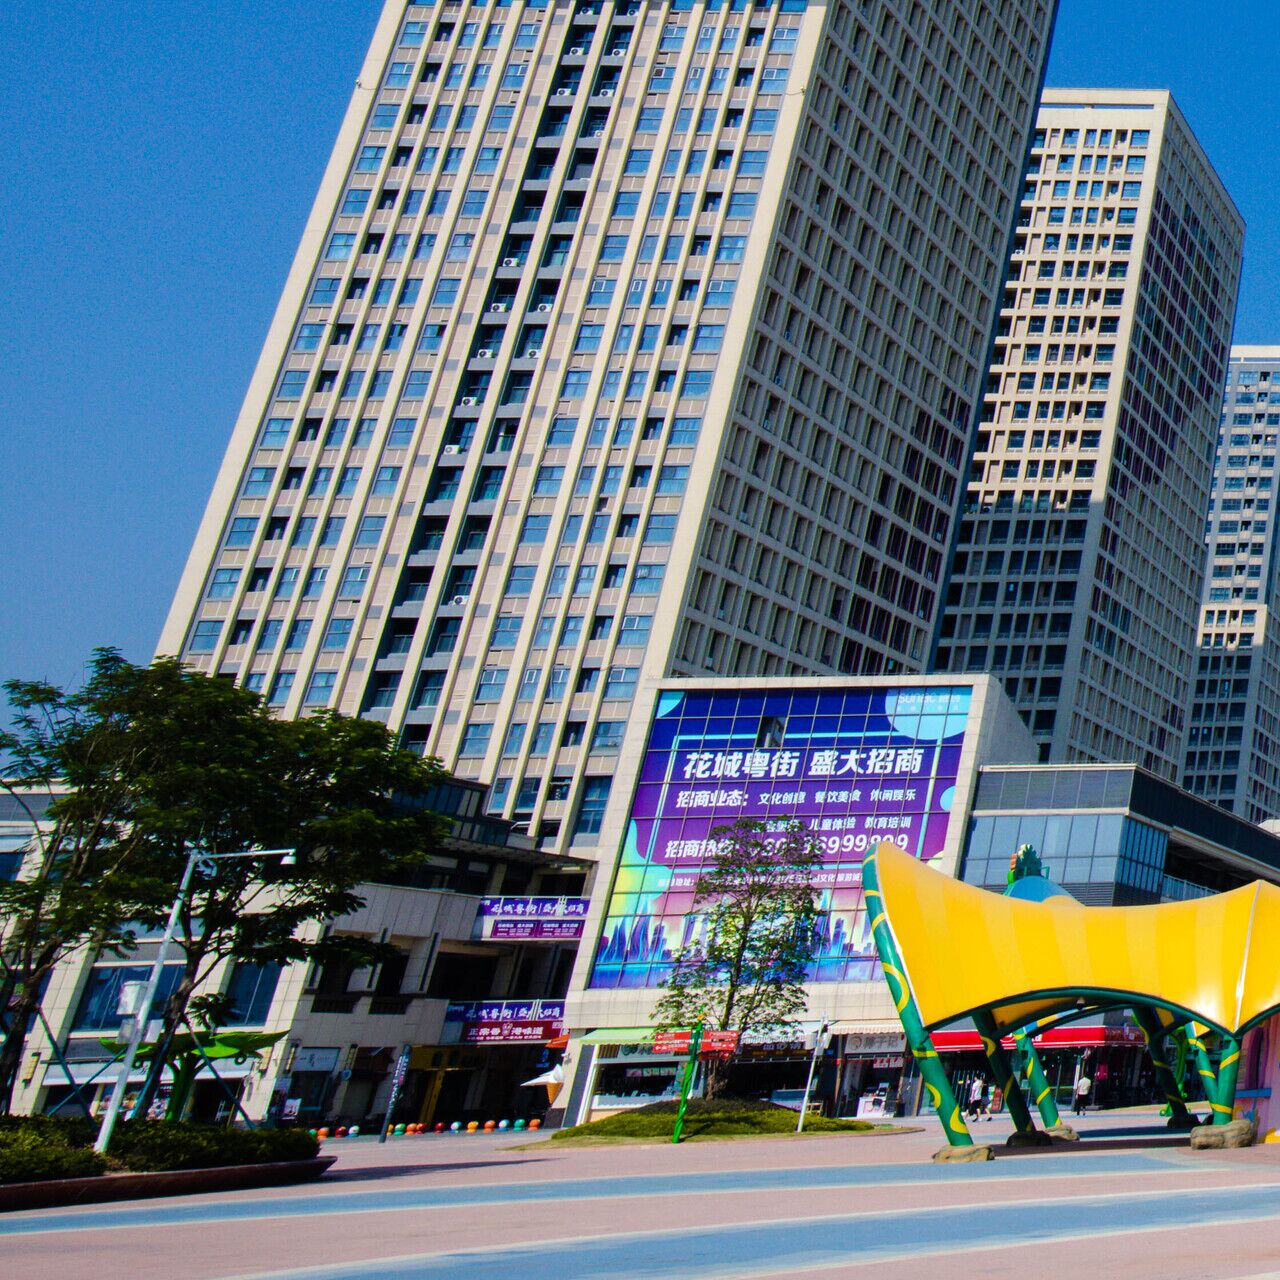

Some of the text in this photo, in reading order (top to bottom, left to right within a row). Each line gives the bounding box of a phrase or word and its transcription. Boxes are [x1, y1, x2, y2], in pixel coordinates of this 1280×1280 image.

[683, 747, 925, 780] 花城粤街 盛大招商
[757, 790, 806, 806] 文化创意
[815, 789, 862, 805] 餐饮美食
[870, 788, 916, 802] 休闲娱乐
[808, 817, 856, 831] 儿童体验
[864, 816, 912, 829] 教育培训
